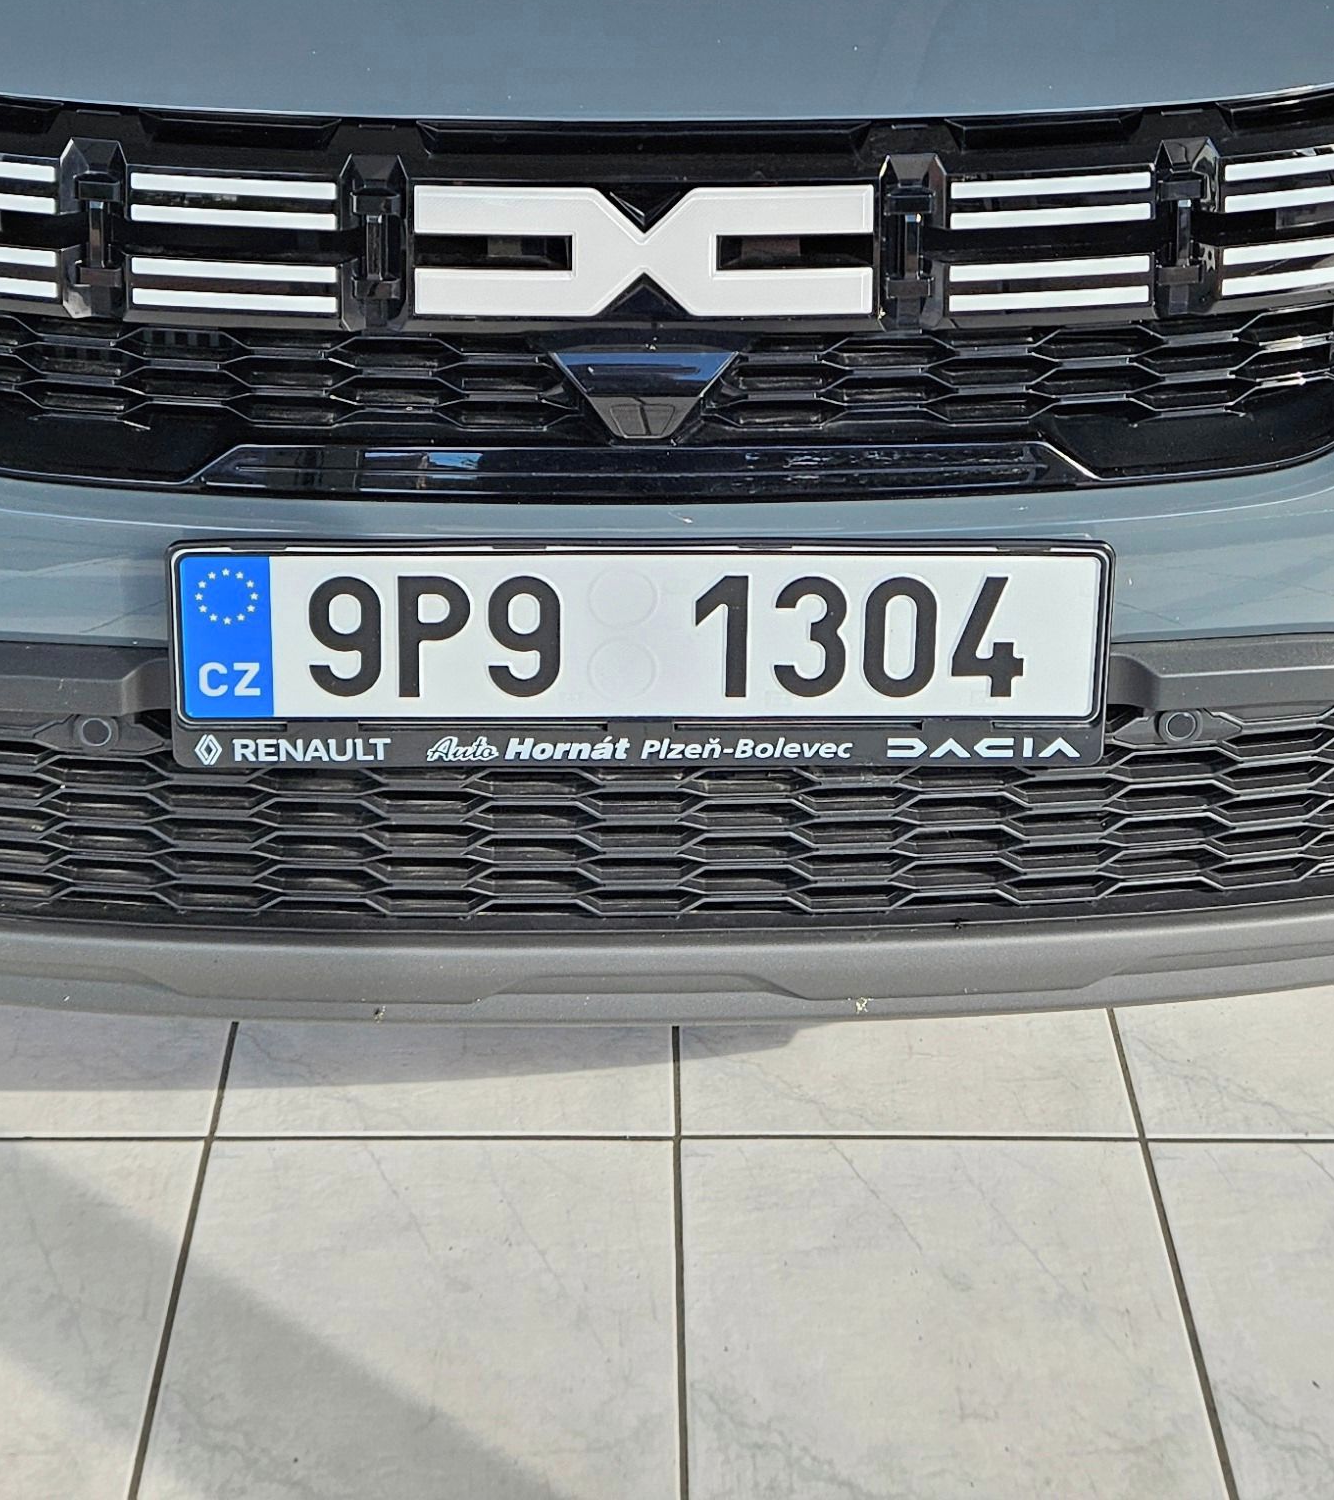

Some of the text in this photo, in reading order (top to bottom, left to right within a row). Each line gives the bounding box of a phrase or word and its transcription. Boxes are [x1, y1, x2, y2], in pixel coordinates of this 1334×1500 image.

[307, 574, 1025, 700] 9P9 1304
[197, 660, 263, 697] CZ
[233, 738, 392, 762] RENAULT
[426, 735, 854, 763] Auto Hornát Plzeň-Bolevec
[886, 737, 1081, 759] DACIA
